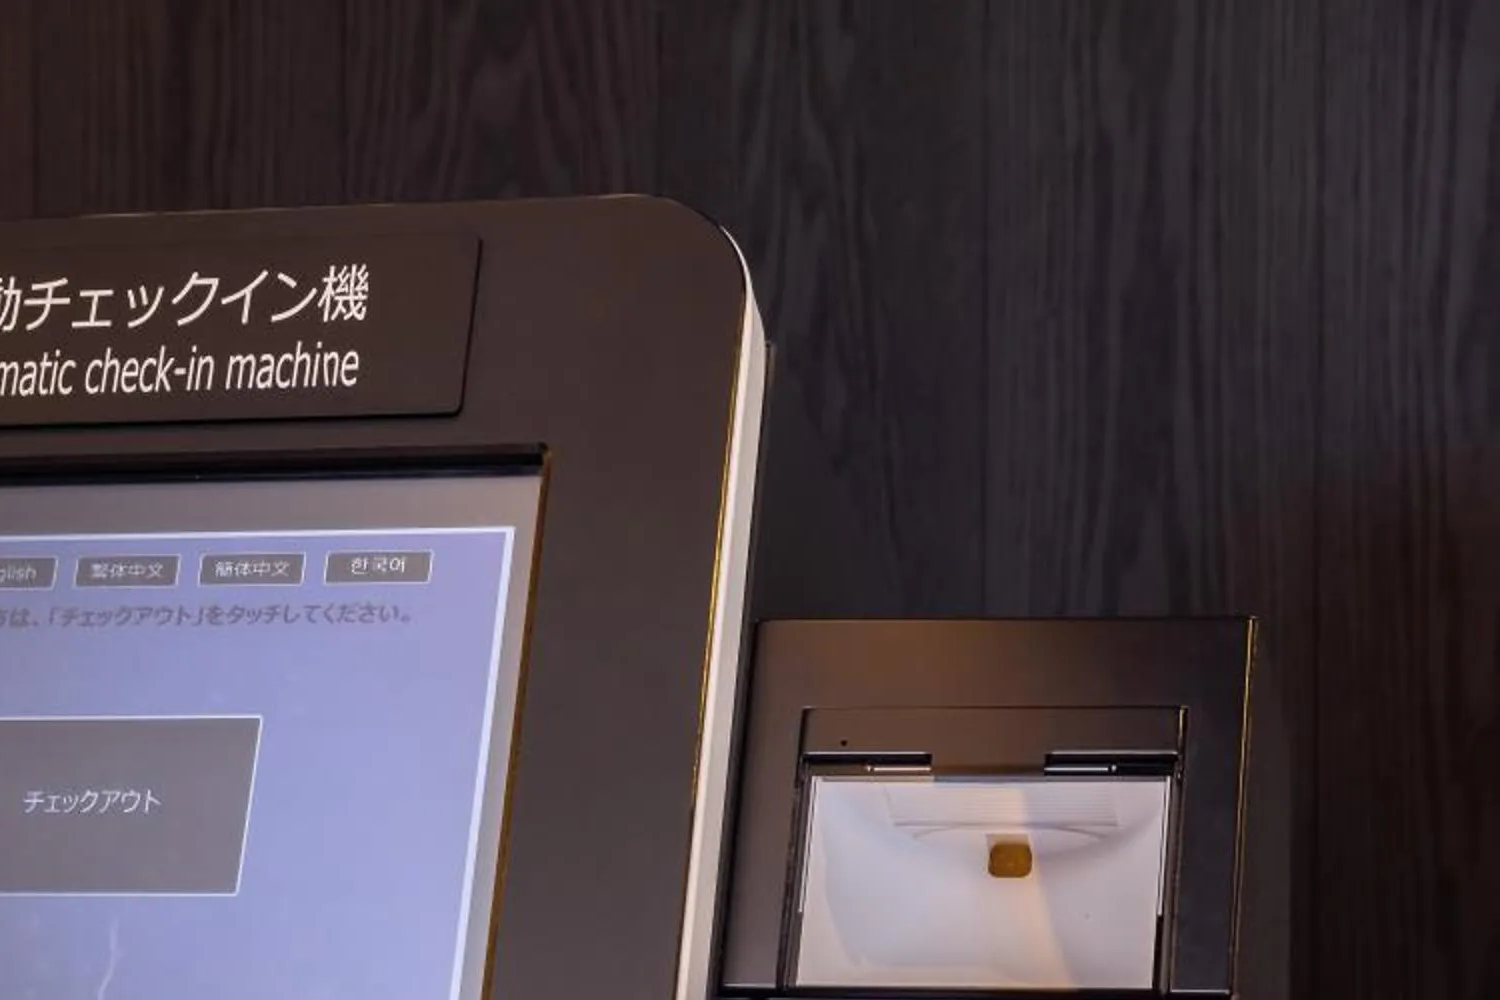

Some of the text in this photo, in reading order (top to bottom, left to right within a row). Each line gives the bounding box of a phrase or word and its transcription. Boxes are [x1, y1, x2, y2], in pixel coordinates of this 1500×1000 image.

[85, 346, 215, 395] check-in
[226, 341, 360, 390] machine
[23, 789, 161, 814] チェックアウト
